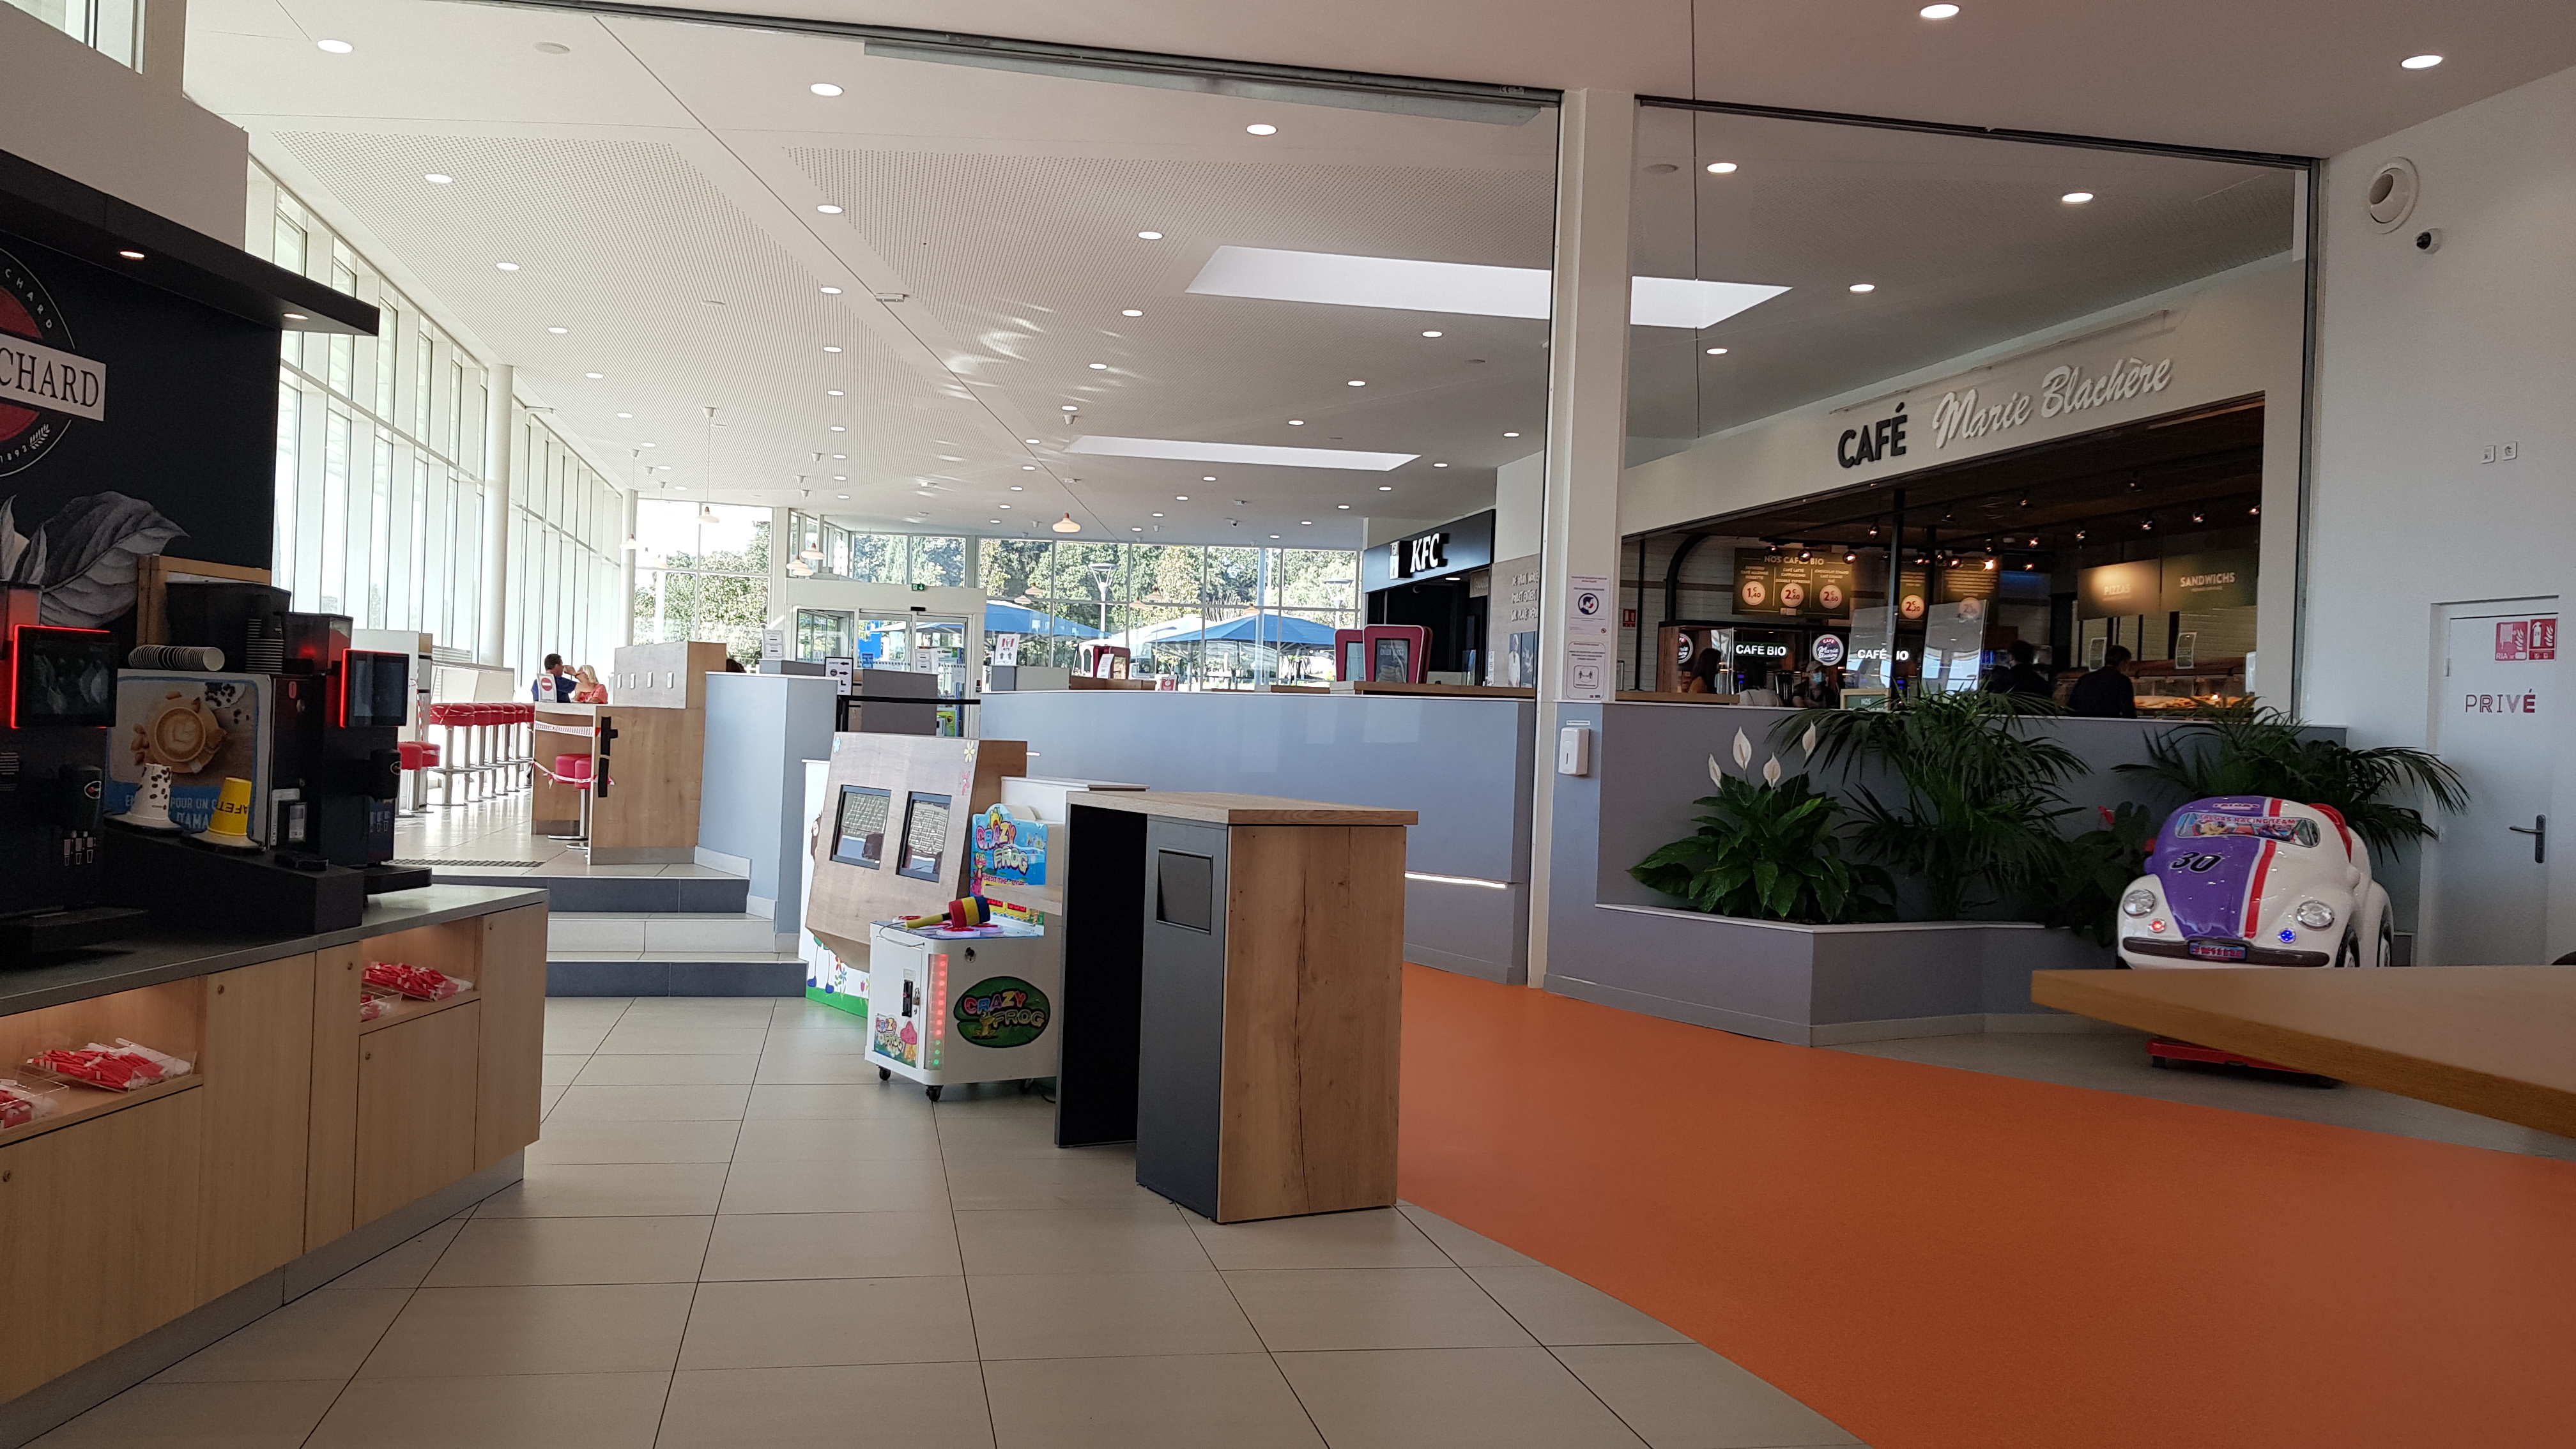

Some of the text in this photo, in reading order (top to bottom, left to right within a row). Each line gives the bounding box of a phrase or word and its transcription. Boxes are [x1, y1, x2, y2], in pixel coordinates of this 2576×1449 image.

[1837, 356, 2173, 468] CAFÉ Marie Blachère
[1409, 533, 1440, 573] KFC
[2104, 584, 2131, 595] PIZZAS
[2180, 572, 2236, 588] SANDWICHS
[1735, 643, 1786, 656] CAFÉ BIO
[1857, 648, 1909, 661] CAFÉ IO
[2465, 688, 2536, 714] PRIVÉ
[171, 797, 192, 809] POUR
[196, 798, 208, 809] UN
[216, 801, 249, 815] AFET
[976, 820, 1017, 851] CRAZY
[993, 845, 1029, 875] FROG
[2170, 851, 2223, 873] 30
[963, 989, 1027, 1015] CRAZY
[992, 1009, 1046, 1029] FROG
[885, 1033, 903, 1052] FROG
